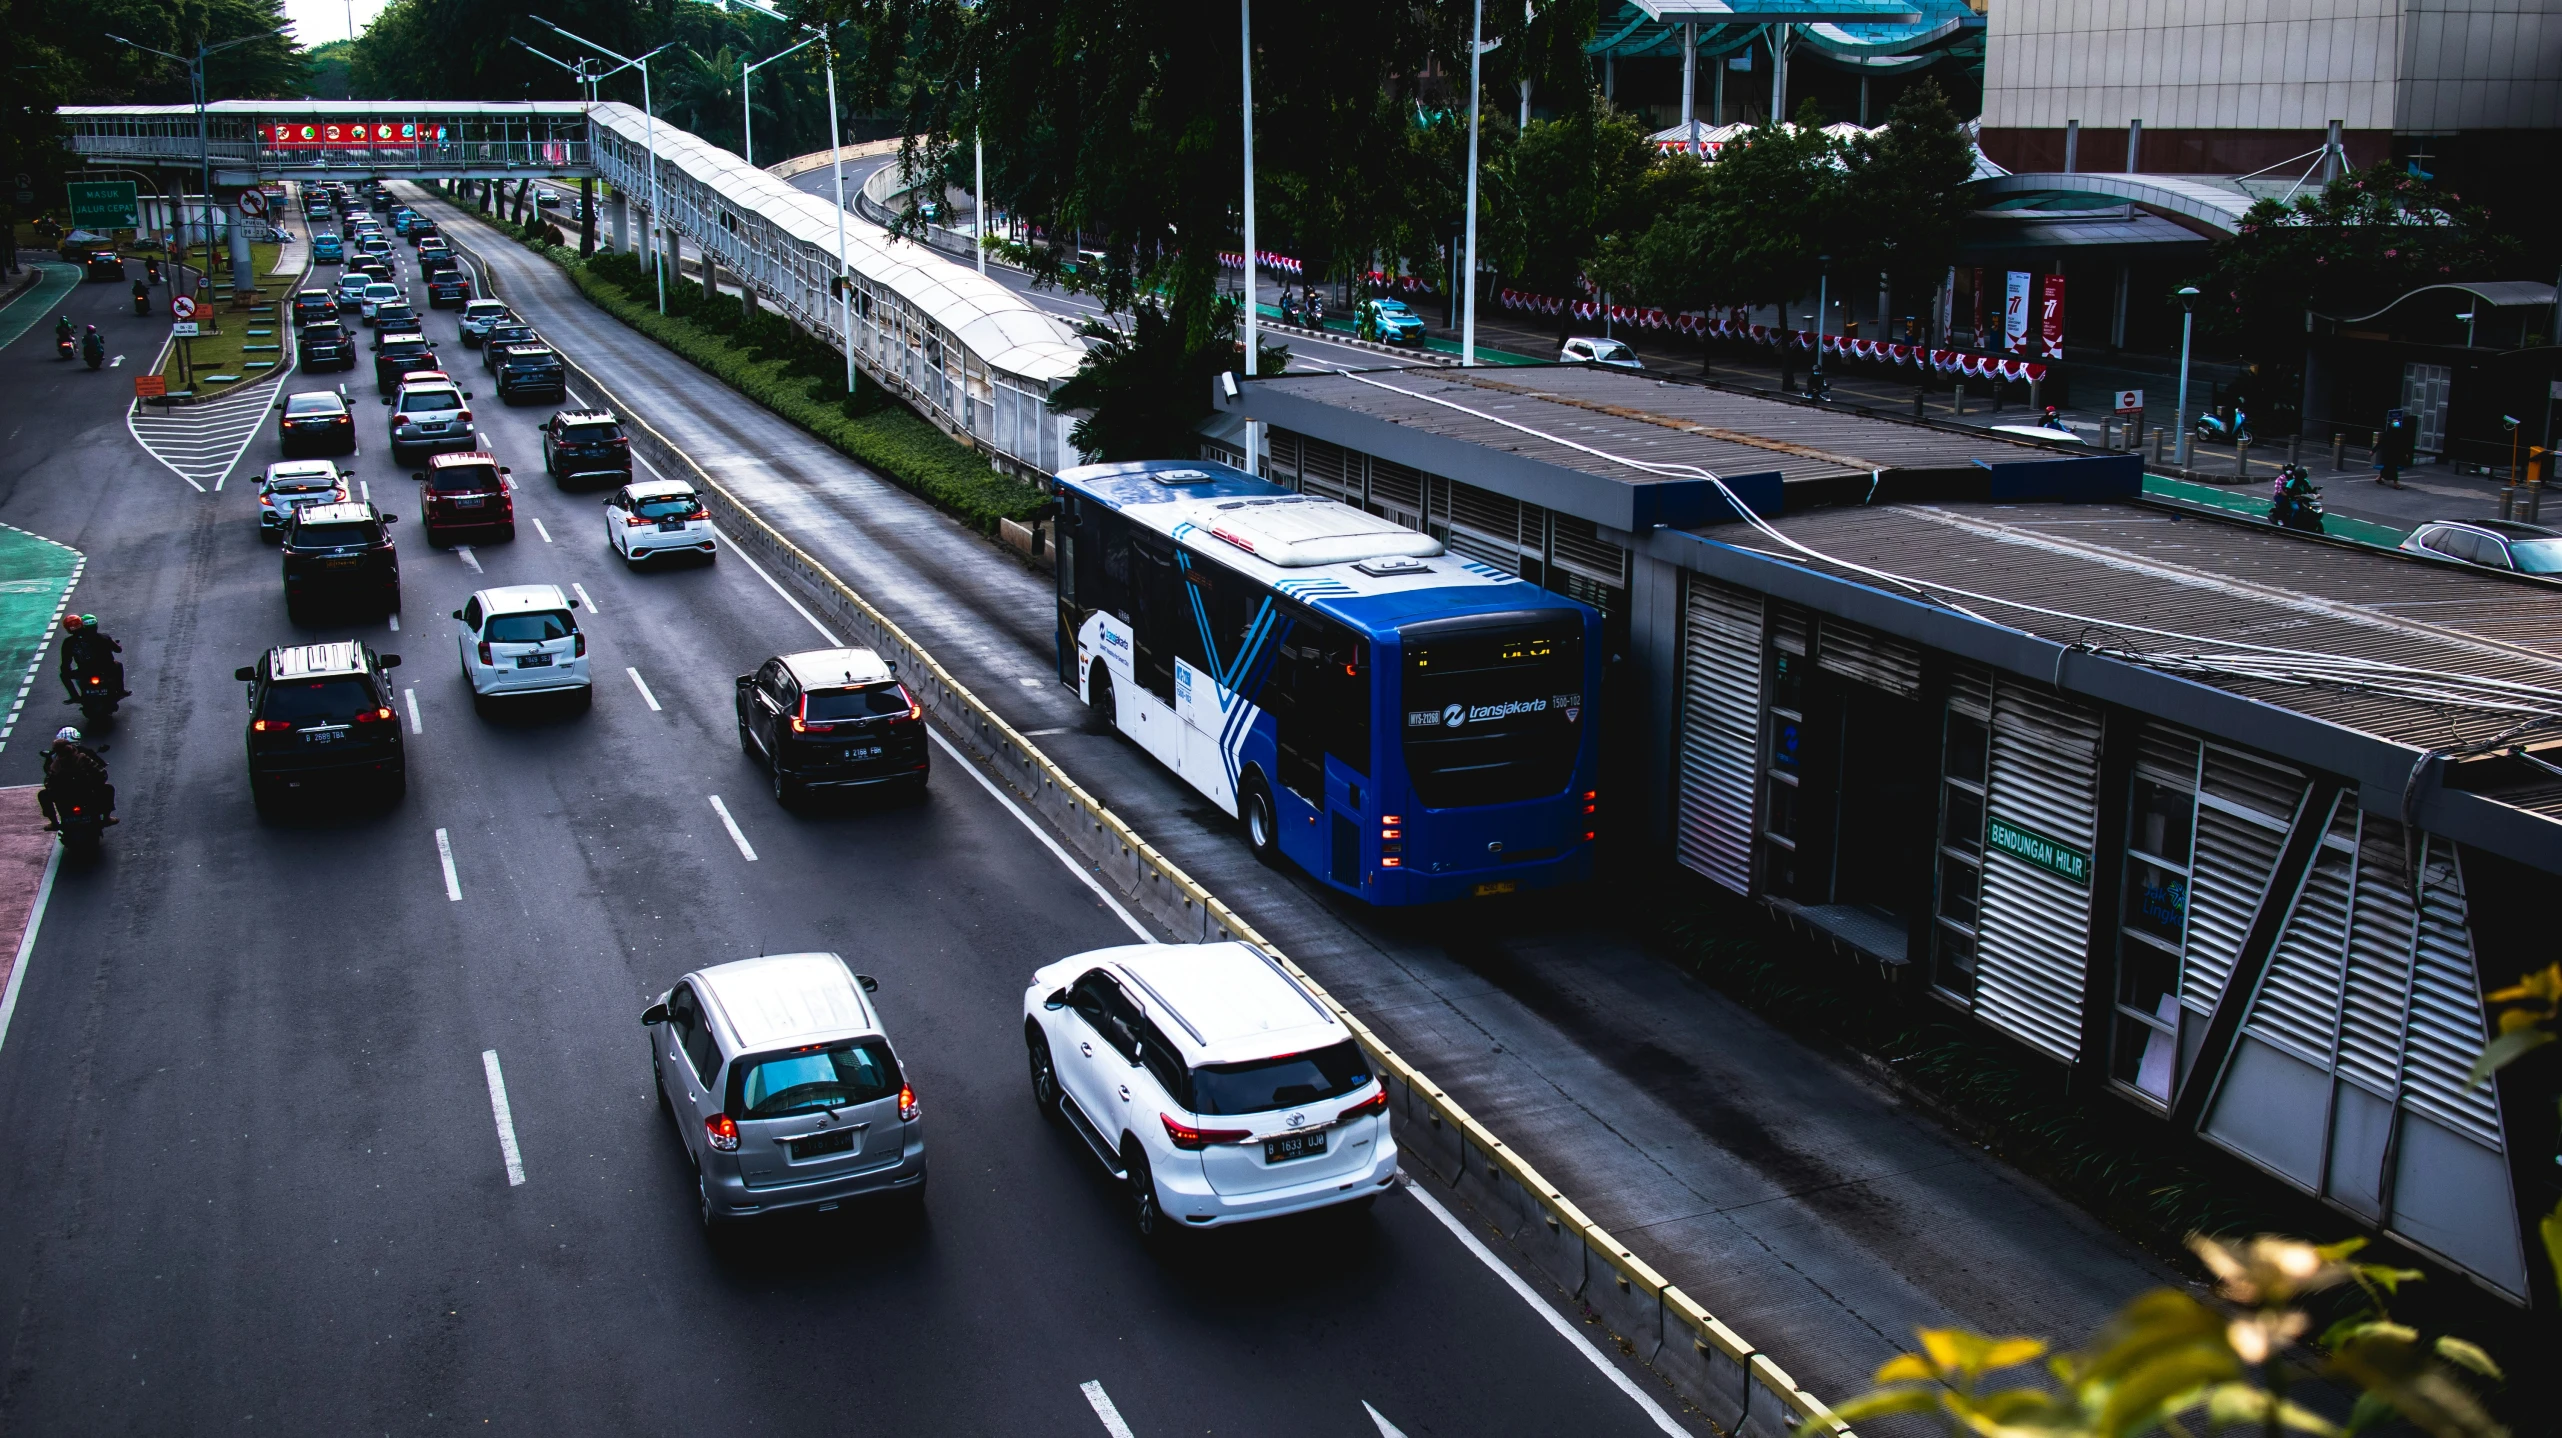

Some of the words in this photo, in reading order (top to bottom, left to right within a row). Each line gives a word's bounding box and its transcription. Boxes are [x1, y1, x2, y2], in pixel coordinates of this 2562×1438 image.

[86, 190, 120, 199] MASUK
[75, 205, 105, 214] JALUR
[107, 204, 134, 212] CEPAT
[2008, 296, 2022, 315] 77
[2043, 299, 2058, 320] 77
[1469, 698, 1546, 721] transjakarta
[1552, 695, 1580, 708] 1500-102
[844, 750, 850, 758] B
[1991, 824, 2053, 865] BENDUNGAN
[1268, 1144, 1274, 1154] B
[1282, 1138, 1302, 1152] 1633
